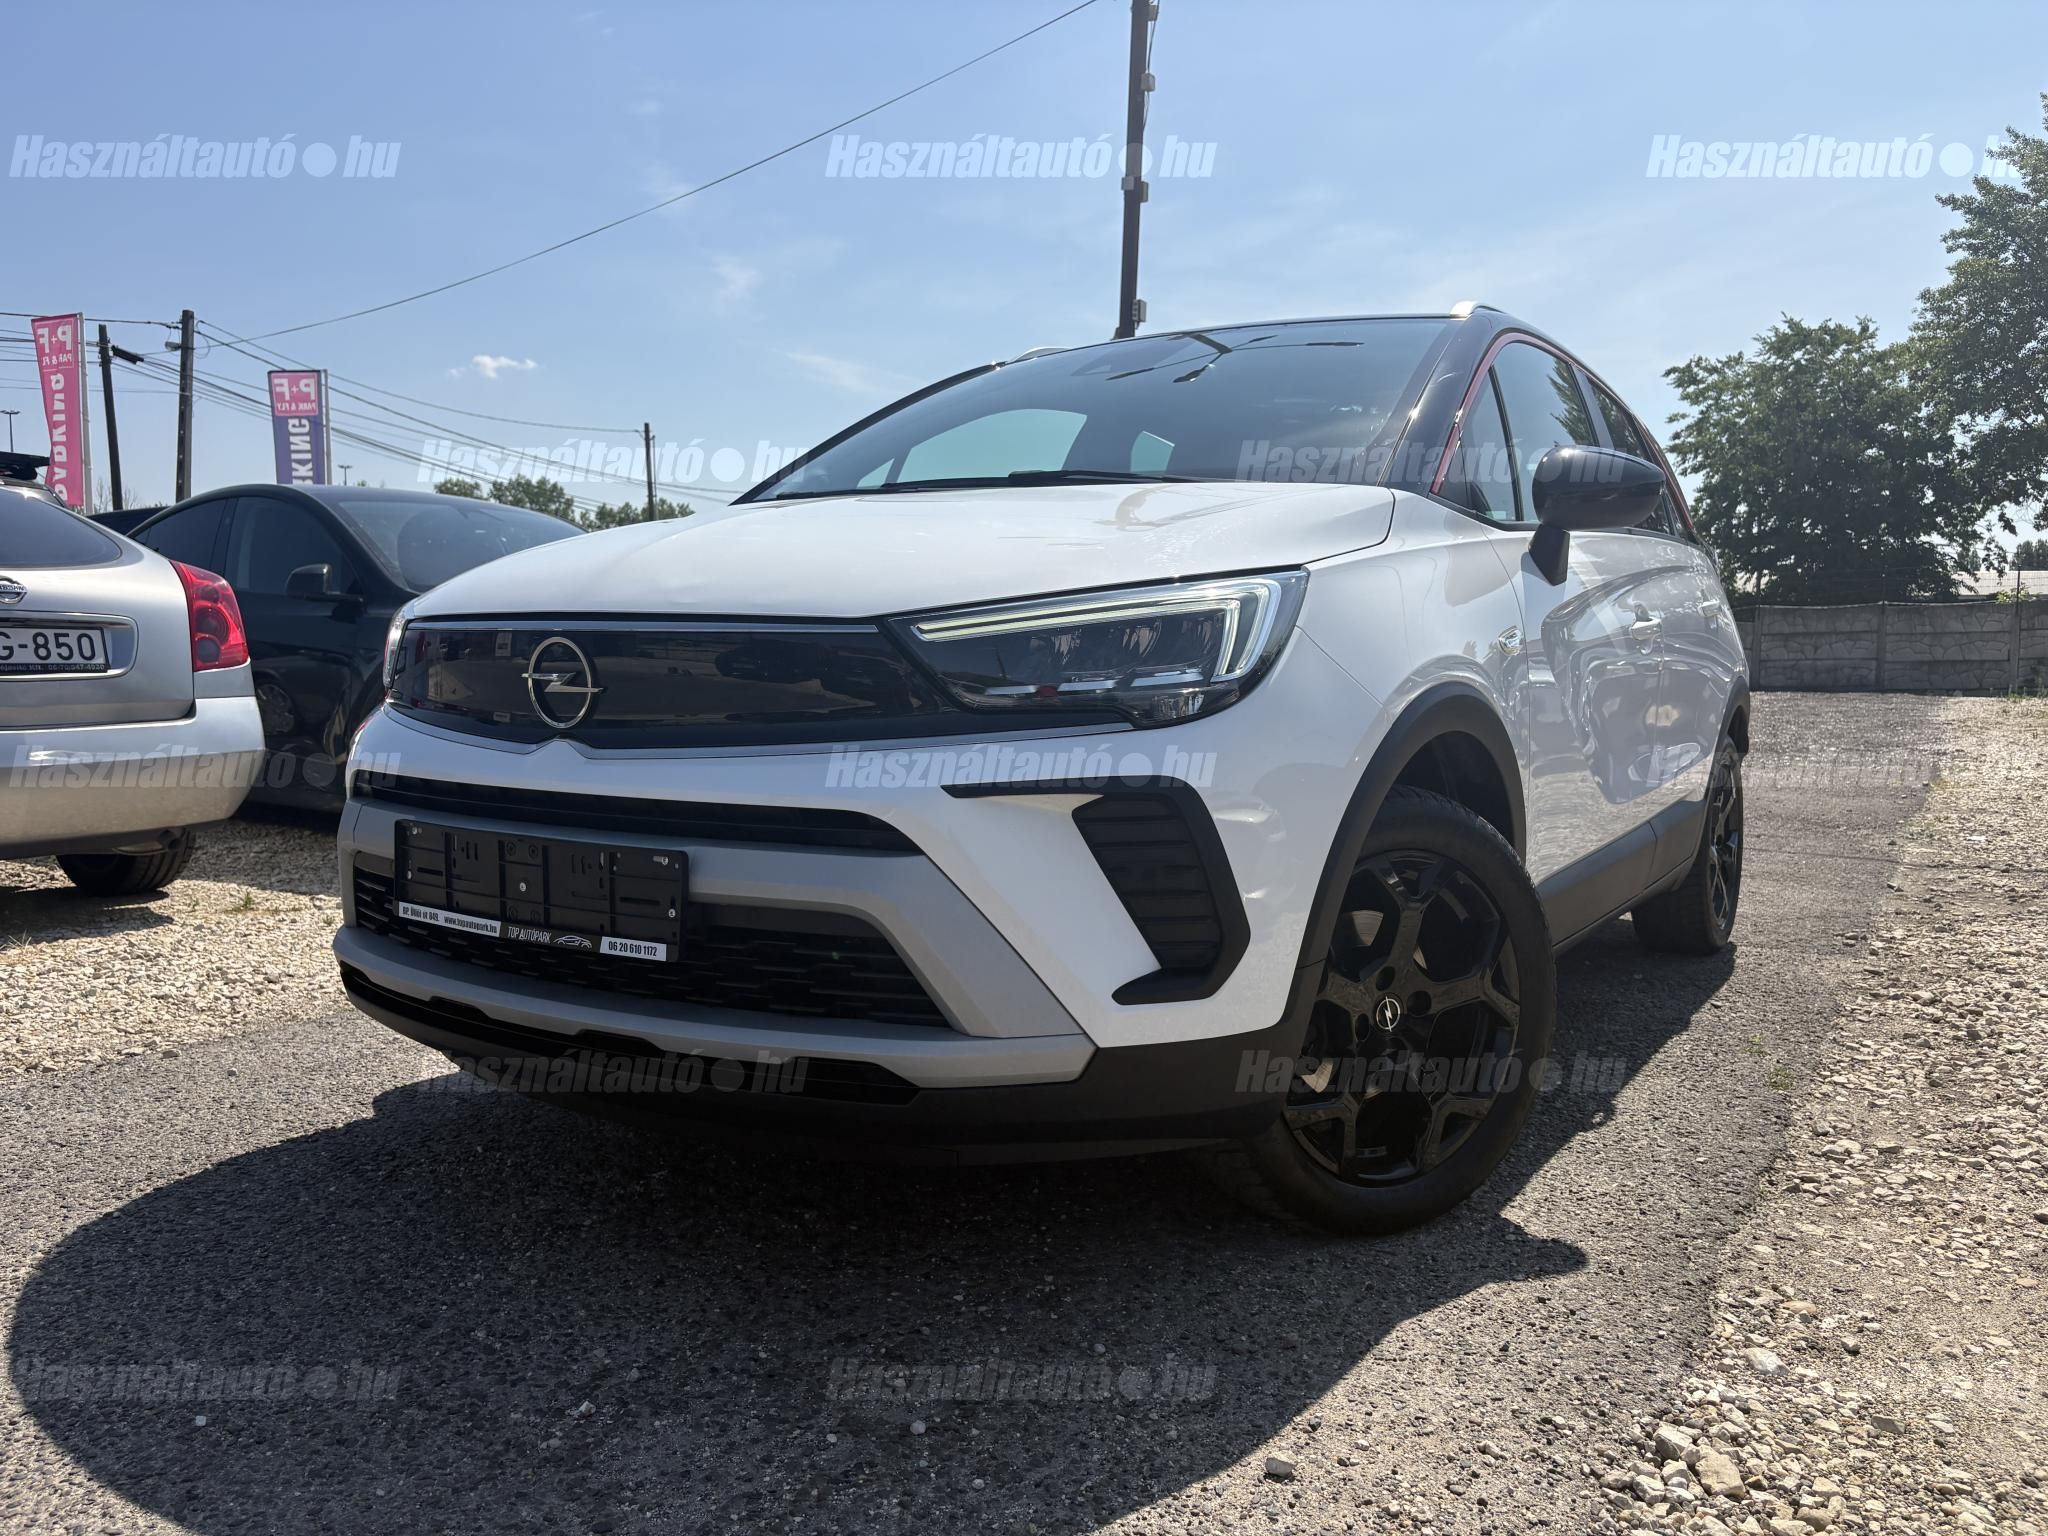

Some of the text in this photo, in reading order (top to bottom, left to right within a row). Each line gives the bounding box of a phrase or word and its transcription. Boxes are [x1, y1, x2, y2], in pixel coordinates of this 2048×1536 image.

[507, 926, 520, 939] TOP
[608, 940, 658, 957] 06 20 610 1172
